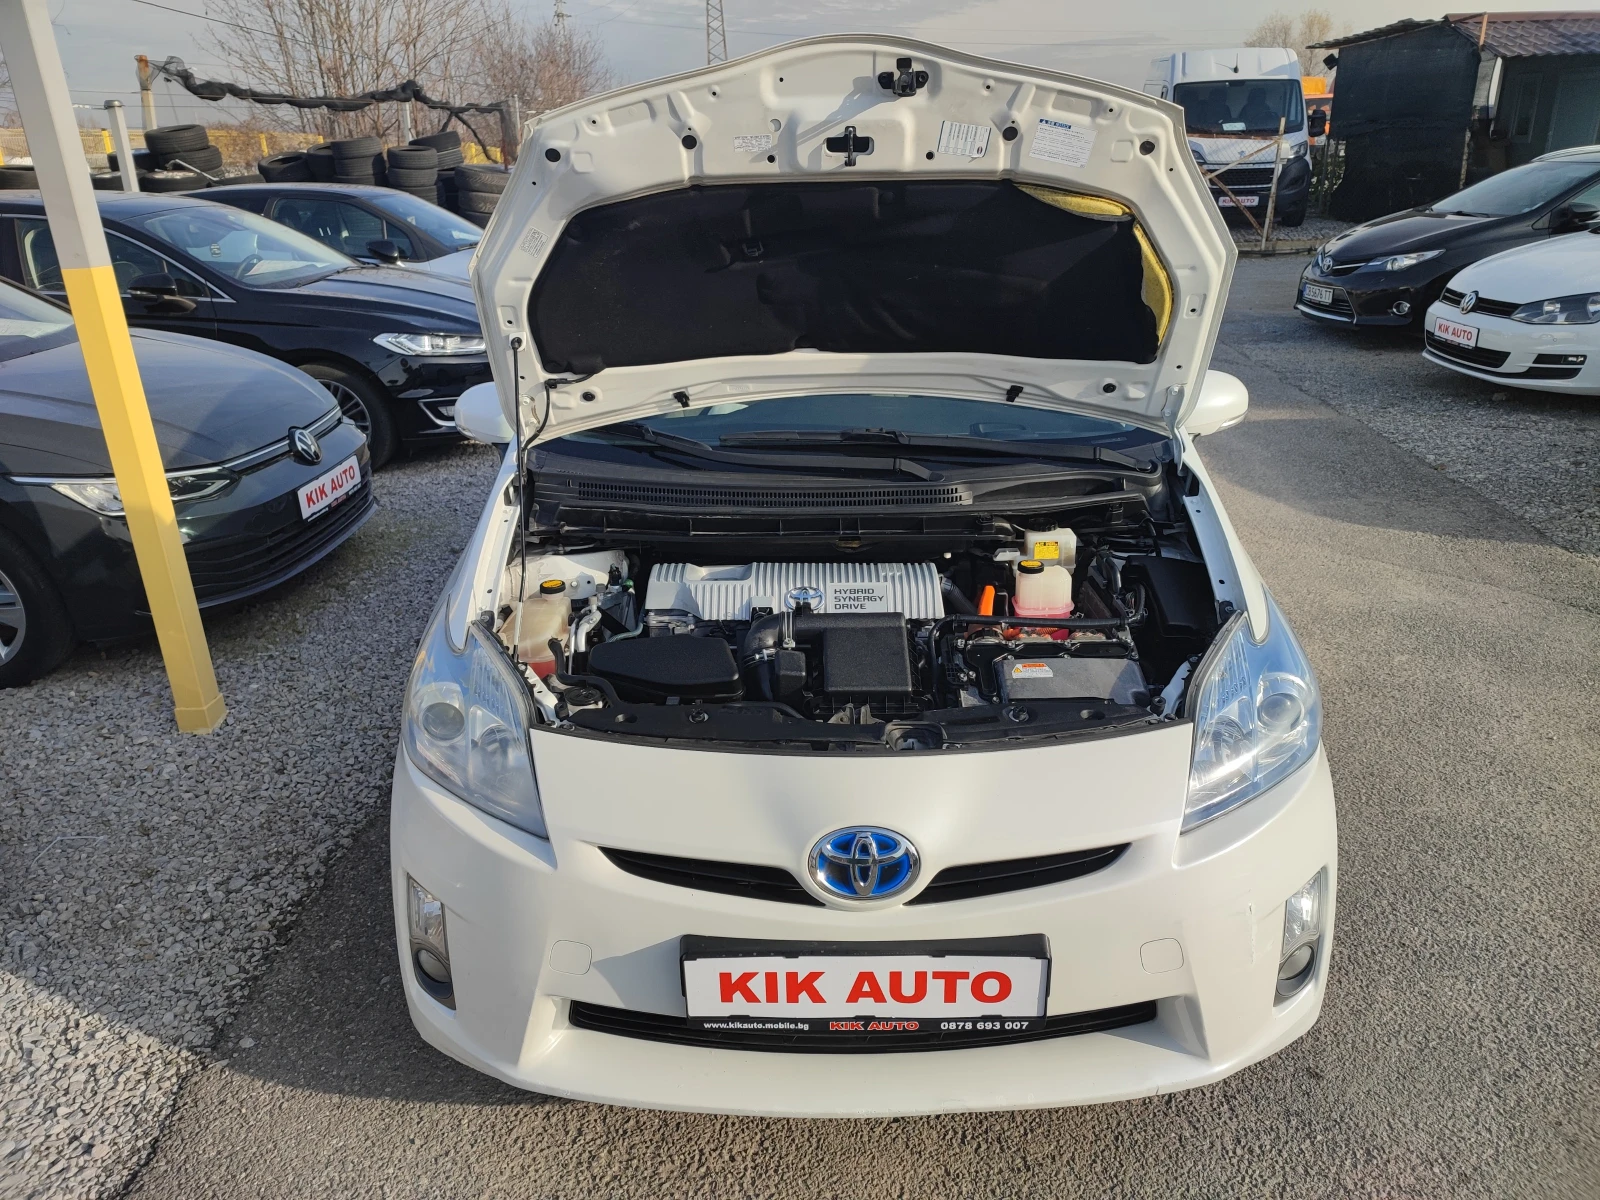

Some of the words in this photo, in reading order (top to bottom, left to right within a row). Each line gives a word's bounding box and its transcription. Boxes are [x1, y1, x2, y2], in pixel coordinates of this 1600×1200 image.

[1438, 322, 1451, 335] KIK
[1451, 327, 1473, 342] AUTO
[305, 482, 329, 509] KIK
[331, 464, 356, 495] AUTO
[834, 595, 885, 603] SYNERGY
[718, 970, 827, 1005] KIK
[845, 970, 1013, 1005] AUTO
[703, 1021, 810, 1031] www.kikauto.mobile.bg
[829, 1021, 865, 1031] KIK
[867, 1021, 920, 1031] AUTO
[940, 1021, 973, 1031] 0878
[976, 1021, 1001, 1030] 693
[1004, 1021, 1029, 1030] 007
